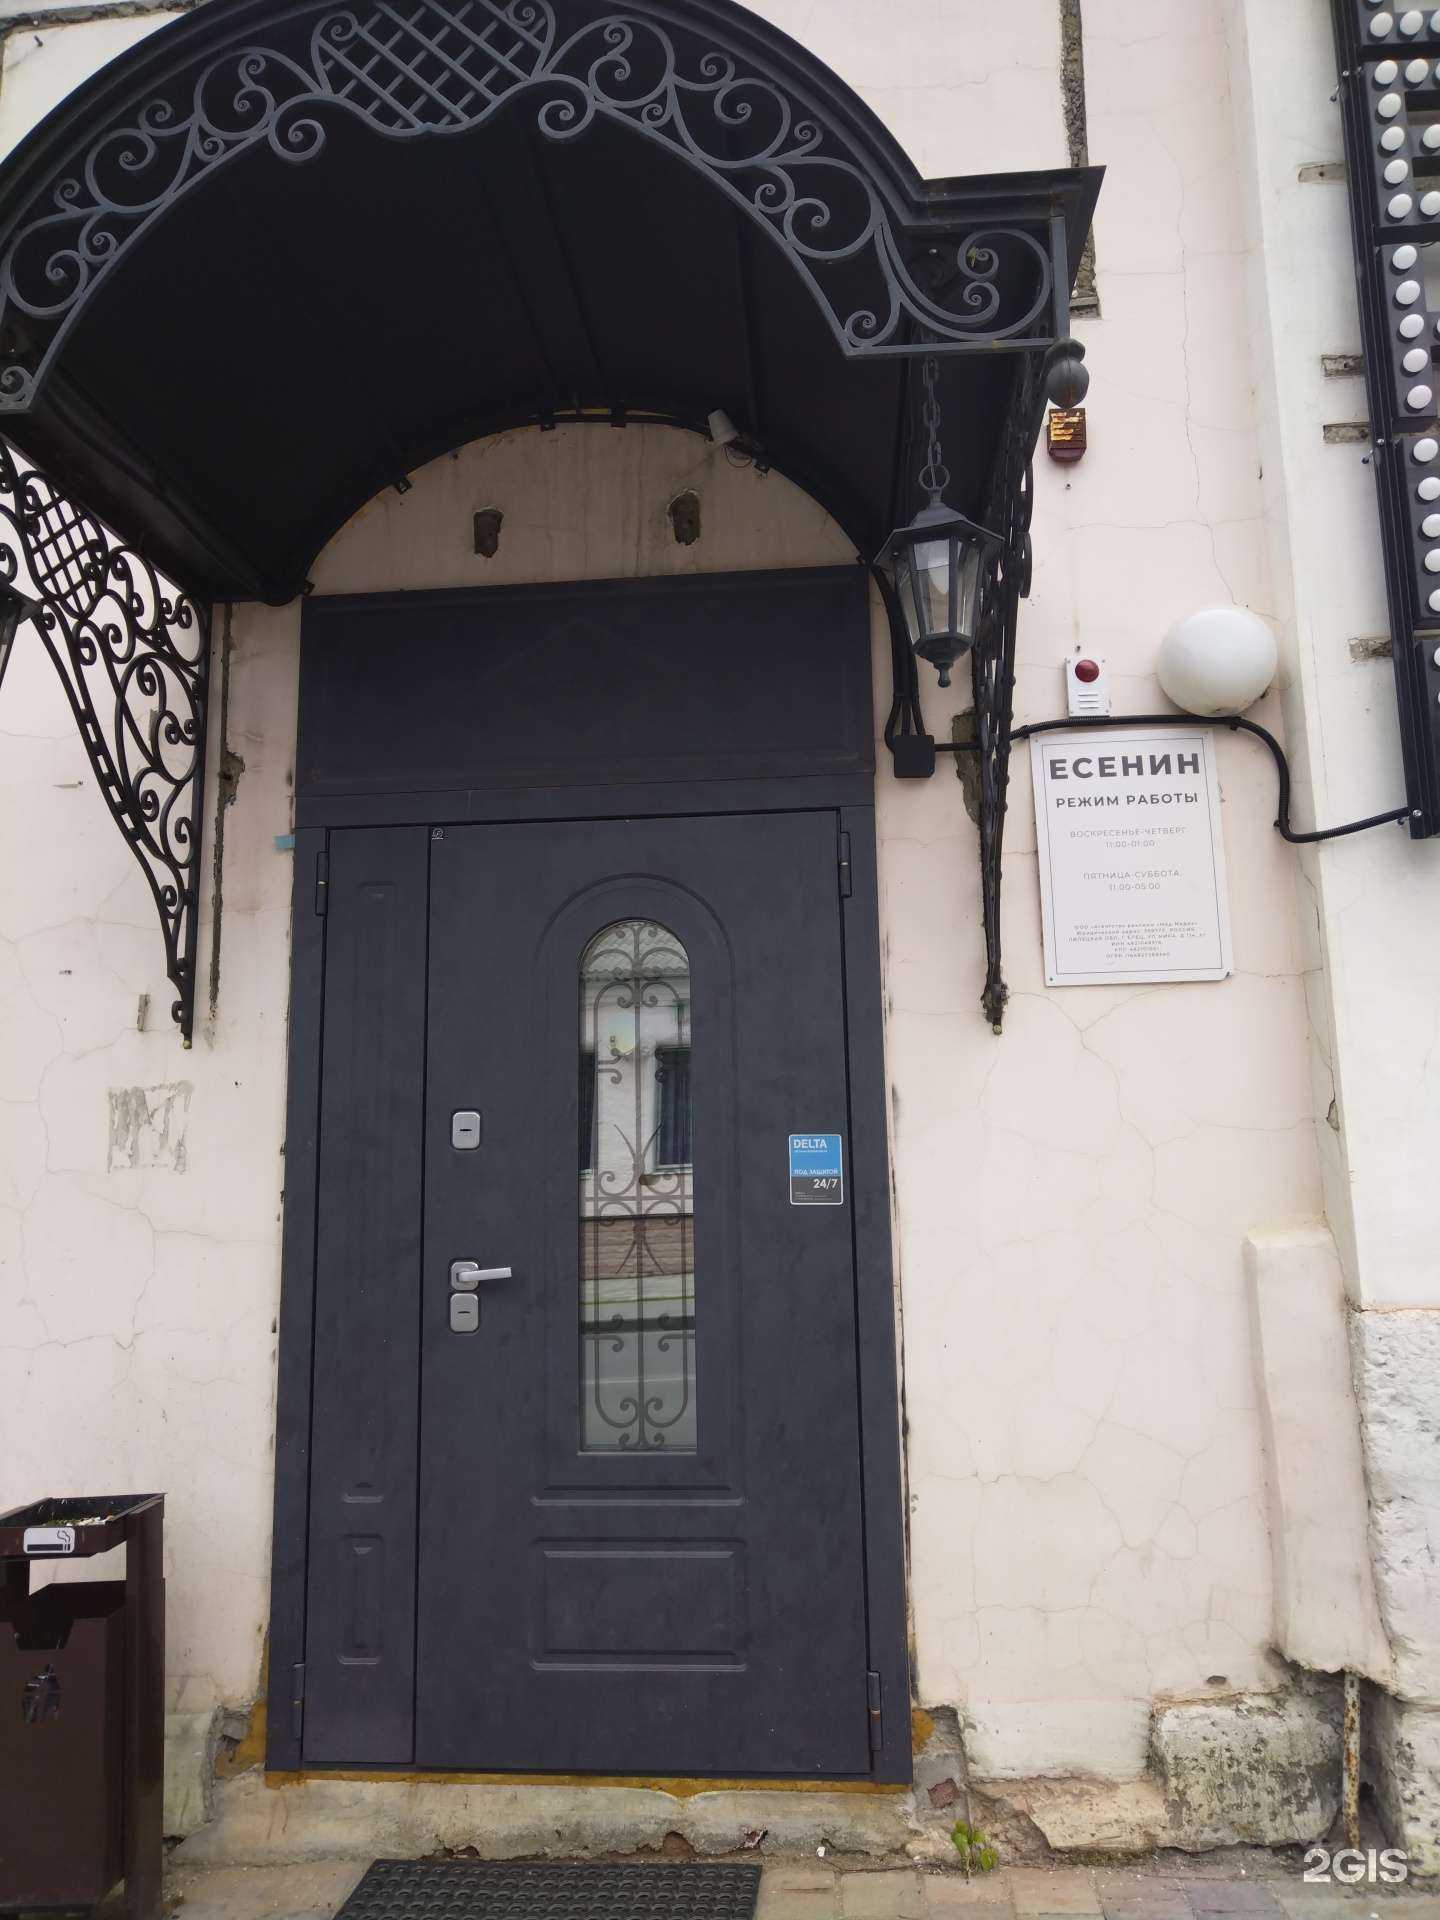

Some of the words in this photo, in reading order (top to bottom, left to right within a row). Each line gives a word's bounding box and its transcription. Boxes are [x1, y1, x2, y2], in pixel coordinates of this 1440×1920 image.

[1049, 753, 1200, 780] ЕСЕНИН
[1056, 795, 1119, 808] РЕЖИМ
[1126, 792, 1198, 805] РАБОТЫ
[793, 1138, 828, 1149] DELTA
[813, 1178, 838, 1190] 24/7
